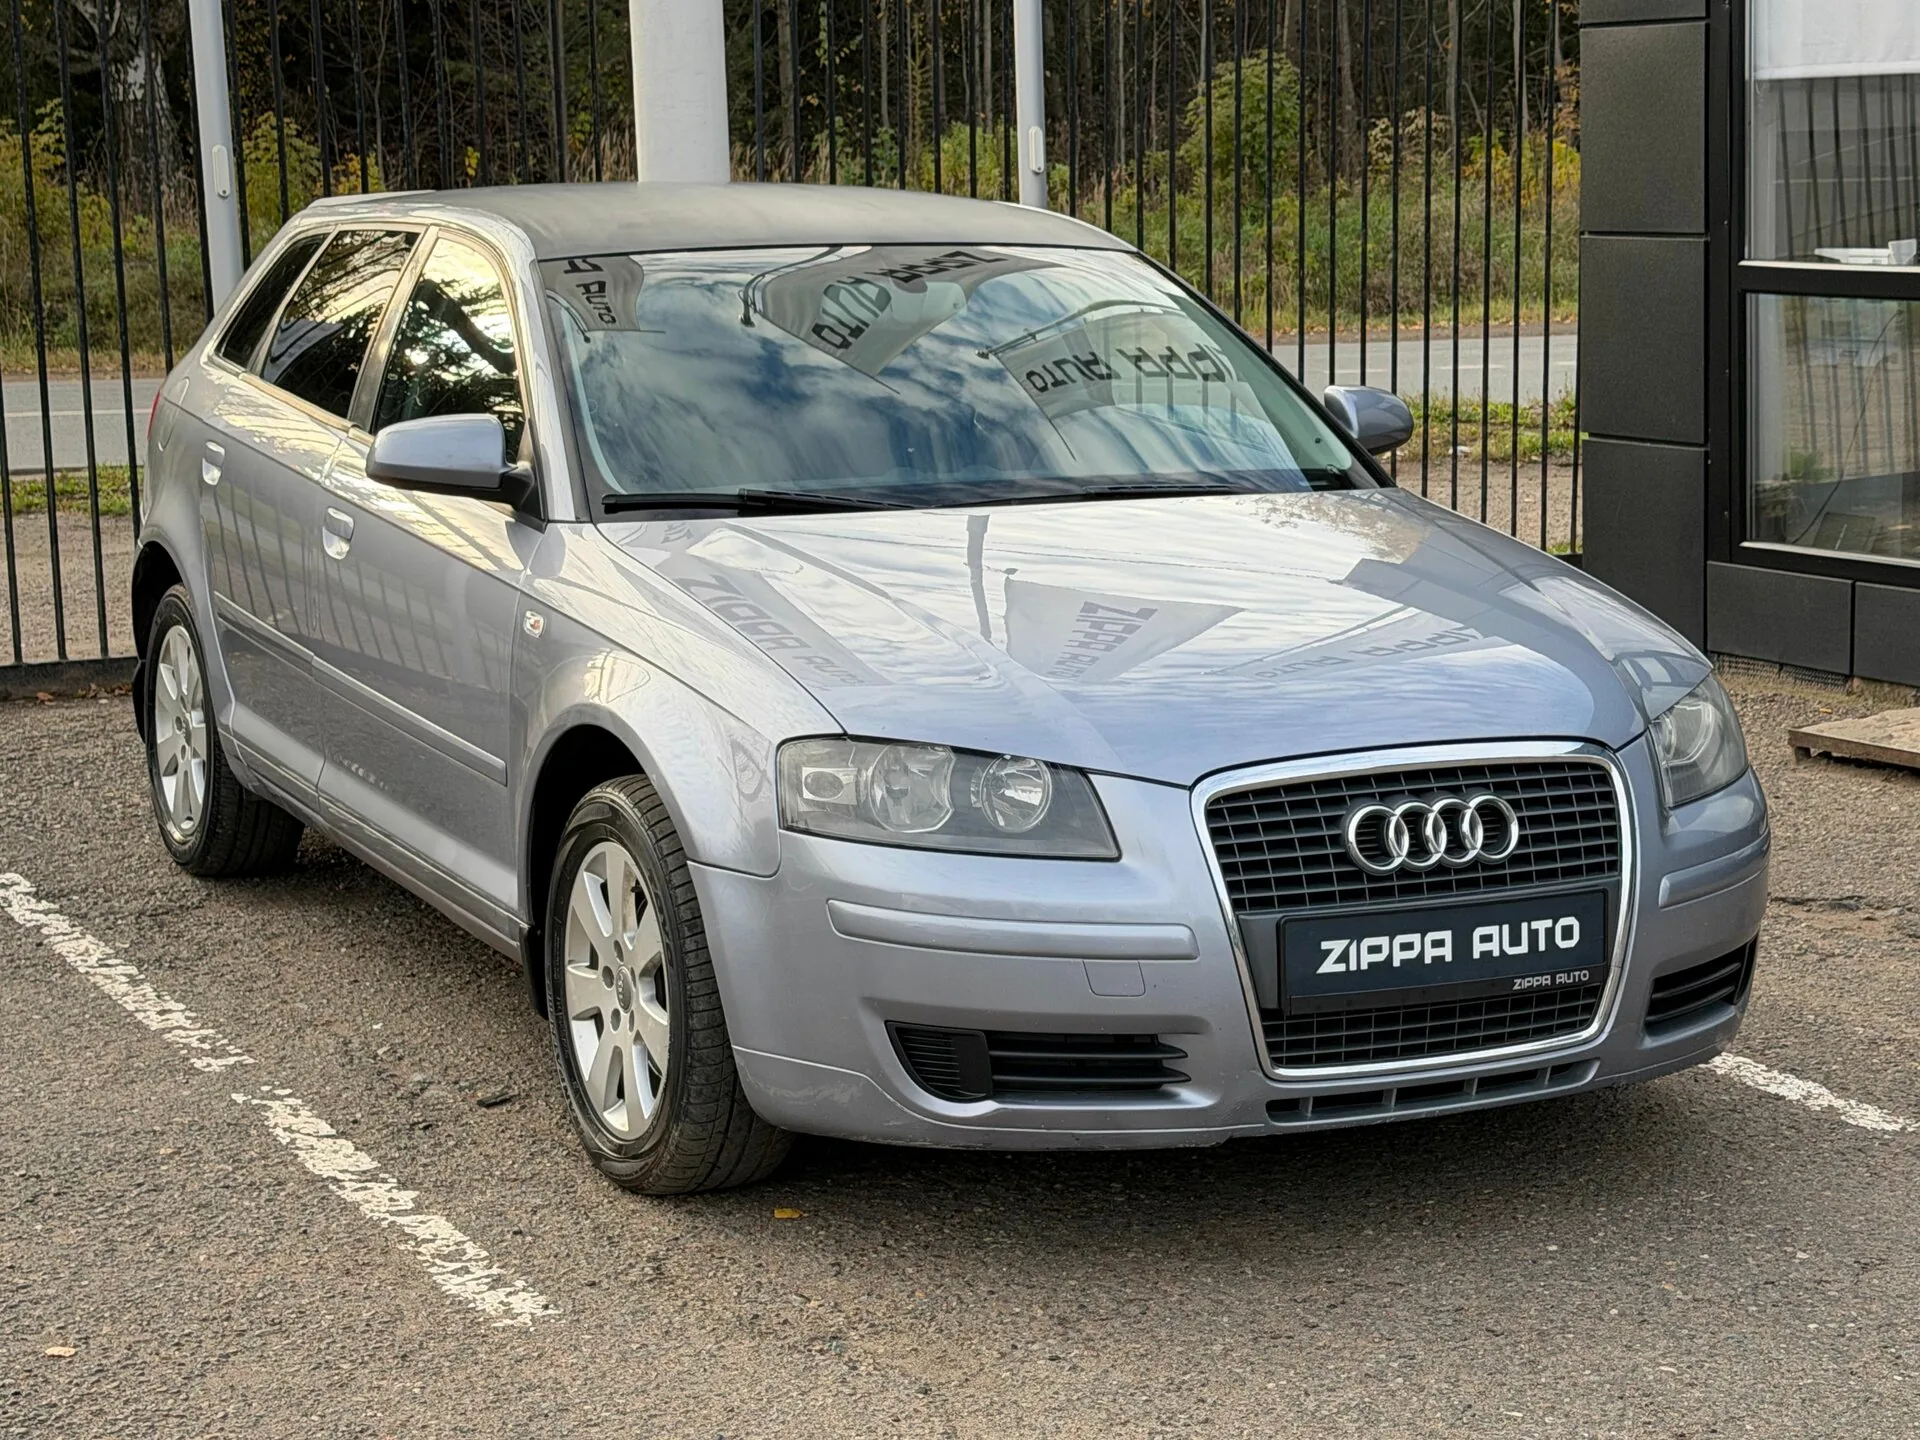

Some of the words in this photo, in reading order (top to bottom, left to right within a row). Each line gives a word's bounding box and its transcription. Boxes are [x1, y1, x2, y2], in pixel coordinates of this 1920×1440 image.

[576, 279, 617, 325] AUTO
[811, 276, 892, 350] AUTO
[1025, 351, 1122, 393] AUTO
[1116, 344, 1235, 382] IPPA
[1316, 930, 1452, 974] ZIPPA
[1472, 916, 1580, 959] AUTO
[1513, 973, 1551, 991] ZIPPA
[1555, 970, 1590, 985] AUTO
